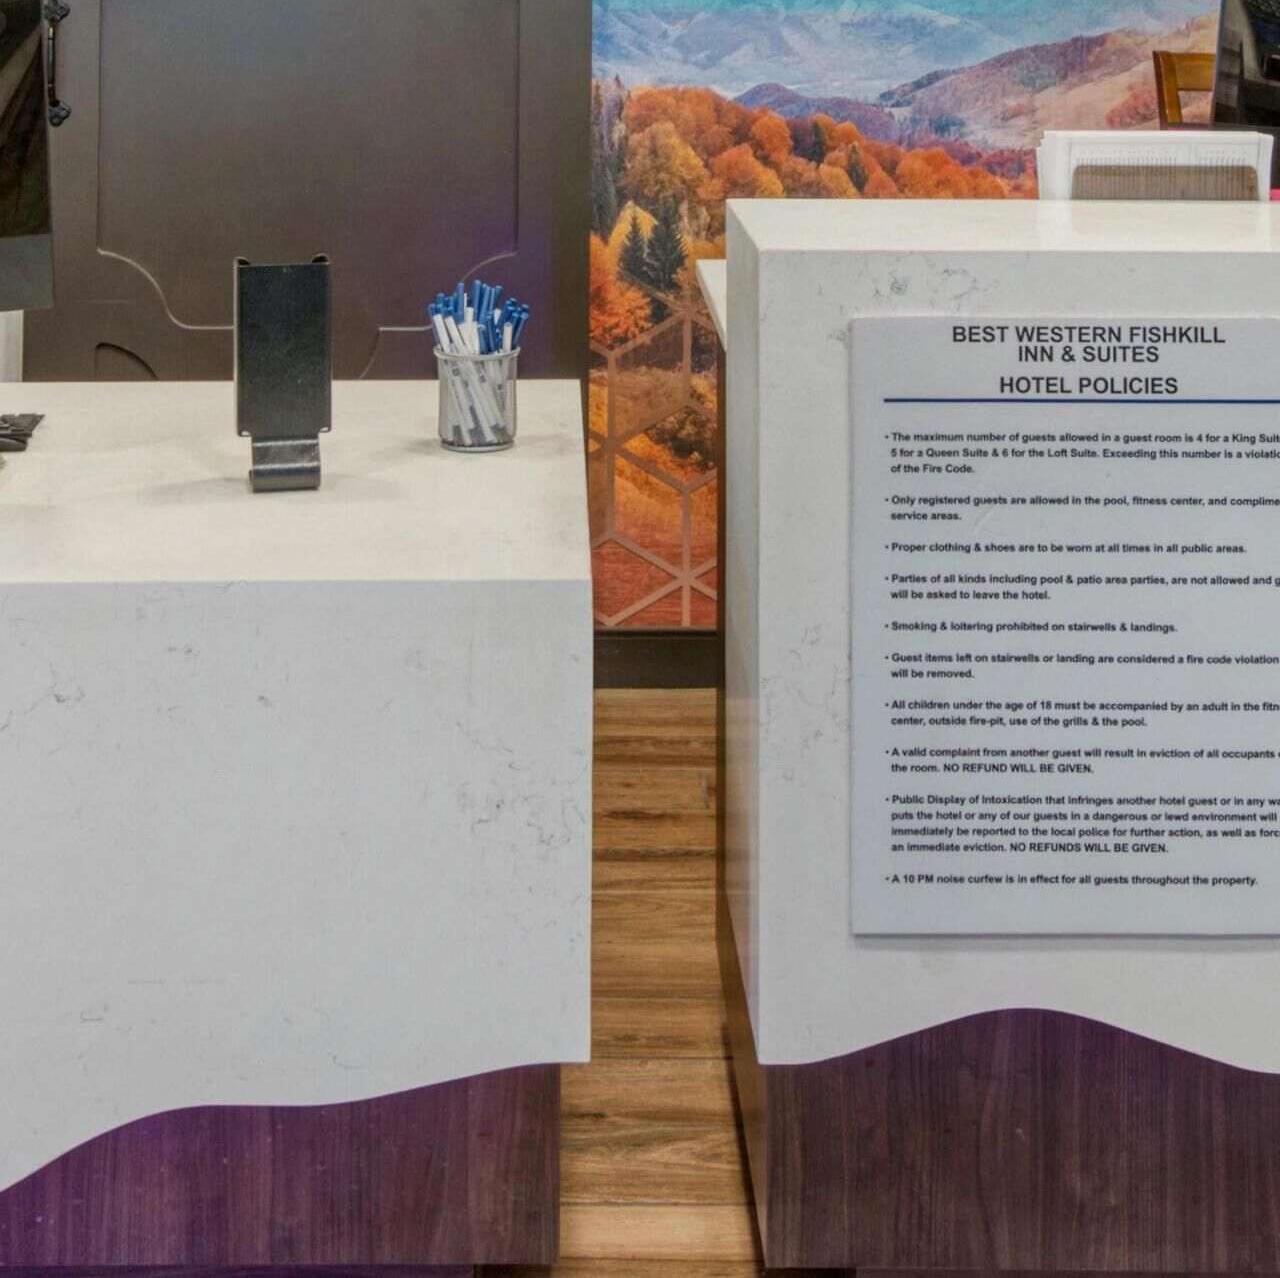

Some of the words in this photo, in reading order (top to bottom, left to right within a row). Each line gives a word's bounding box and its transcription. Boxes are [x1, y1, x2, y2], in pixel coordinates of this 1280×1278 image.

[953, 326, 1009, 342] BEST
[1015, 326, 1121, 343] WESTERN
[1130, 326, 1226, 343] FISHKILL
[1018, 346, 1053, 362] INN
[1062, 346, 1075, 363] &
[1083, 346, 1159, 363] SUITES
[1000, 376, 1072, 394] HOTEL
[1079, 377, 1178, 394] POLICIES
[891, 432, 911, 442] The
[913, 433, 964, 442] maximum
[966, 432, 1006, 442] number
[1008, 432, 1020, 442] of
[1021, 433, 1056, 444] guests
[1059, 433, 1099, 442] allowed
[1101, 433, 1111, 442] in
[1123, 434, 1152, 444] guest
[1154, 435, 1182, 443] room
[1184, 433, 1194, 443] is
[1196, 433, 1203, 442] 4
[1205, 433, 1221, 443] for
[1223, 435, 1229, 443] a
[1232, 434, 1256, 445] King
[891, 448, 897, 458] 5
[899, 448, 914, 457] for
[925, 448, 960, 458] Queen
[962, 448, 989, 458] Suite
[991, 448, 999, 458] &
[1002, 448, 1009, 458] 6
[1011, 448, 1026, 458] for
[1028, 448, 1045, 458] the
[1047, 448, 1068, 458] Loft
[1070, 448, 1100, 458] Suite.
[1102, 448, 1157, 460] Exceeding
[1159, 449, 1179, 458] this
[1181, 449, 1222, 458] number
[1224, 449, 1233, 459] is
[1236, 451, 1243, 459] a
[890, 463, 902, 473] of
[903, 464, 920, 473] the
[922, 463, 943, 474] Fire
[945, 463, 975, 474] Code.
[891, 495, 916, 507] Only
[918, 495, 971, 507] registered
[973, 496, 1008, 507] guests
[1010, 497, 1027, 505] are
[1029, 495, 1069, 505] allowed
[1072, 496, 1082, 505] in
[1084, 495, 1101, 505] the
[1103, 496, 1129, 507] pool,
[1132, 496, 1168, 505] fitness
[1170, 497, 1205, 506] center,
[1208, 497, 1227, 506] and
[890, 511, 928, 521] service
[930, 513, 962, 521] areas.
[891, 621, 937, 633] Smoking
[939, 621, 948, 631] &
[950, 621, 993, 633] loitering
[996, 622, 1049, 633] prohibited
[1068, 622, 1117, 632] stairwells
[1119, 622, 1128, 632] &
[1130, 622, 1177, 634] landings.
[890, 668, 908, 678] will
[911, 668, 924, 678] be
[926, 669, 975, 678] removed.
[891, 763, 908, 773] the
[943, 763, 960, 773] NO
[962, 763, 1008, 773] REFUND
[1010, 763, 1037, 773] WILL
[1039, 763, 1054, 773] BE
[1057, 763, 1094, 773] GIVEN.
